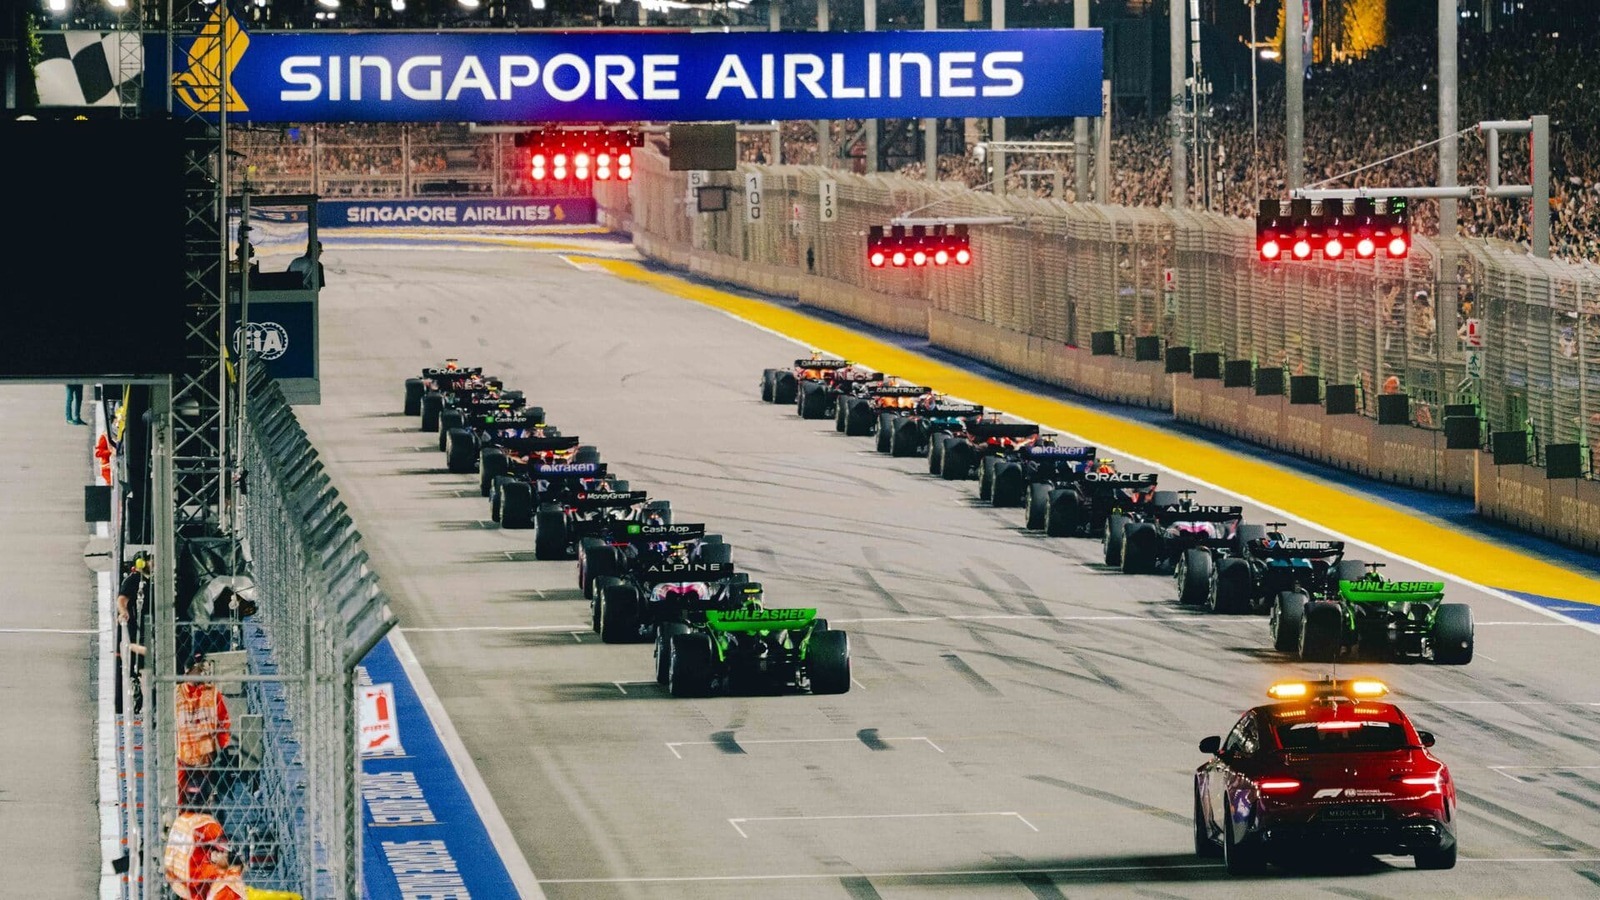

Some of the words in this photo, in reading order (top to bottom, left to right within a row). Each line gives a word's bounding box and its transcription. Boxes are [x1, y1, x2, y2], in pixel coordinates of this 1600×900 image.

[280, 53, 681, 102] SINGAPORE
[705, 51, 1025, 100] AIRLINES
[750, 177, 761, 219] 100
[824, 184, 833, 218] 150
[347, 206, 457, 222] SINGAPORE
[463, 205, 551, 221] AIRLINES
[552, 463, 595, 472] kraken
[1085, 472, 1150, 482] ORACLE
[587, 492, 632, 500] MoneyGram
[668, 525, 690, 534] App
[1278, 540, 1331, 550] Valvoline
[648, 563, 721, 572] ALPINE
[1350, 581, 1435, 593] #UNLEASHED
[717, 608, 807, 621] #UNLEASHED
[363, 724, 391, 733] FIRE
